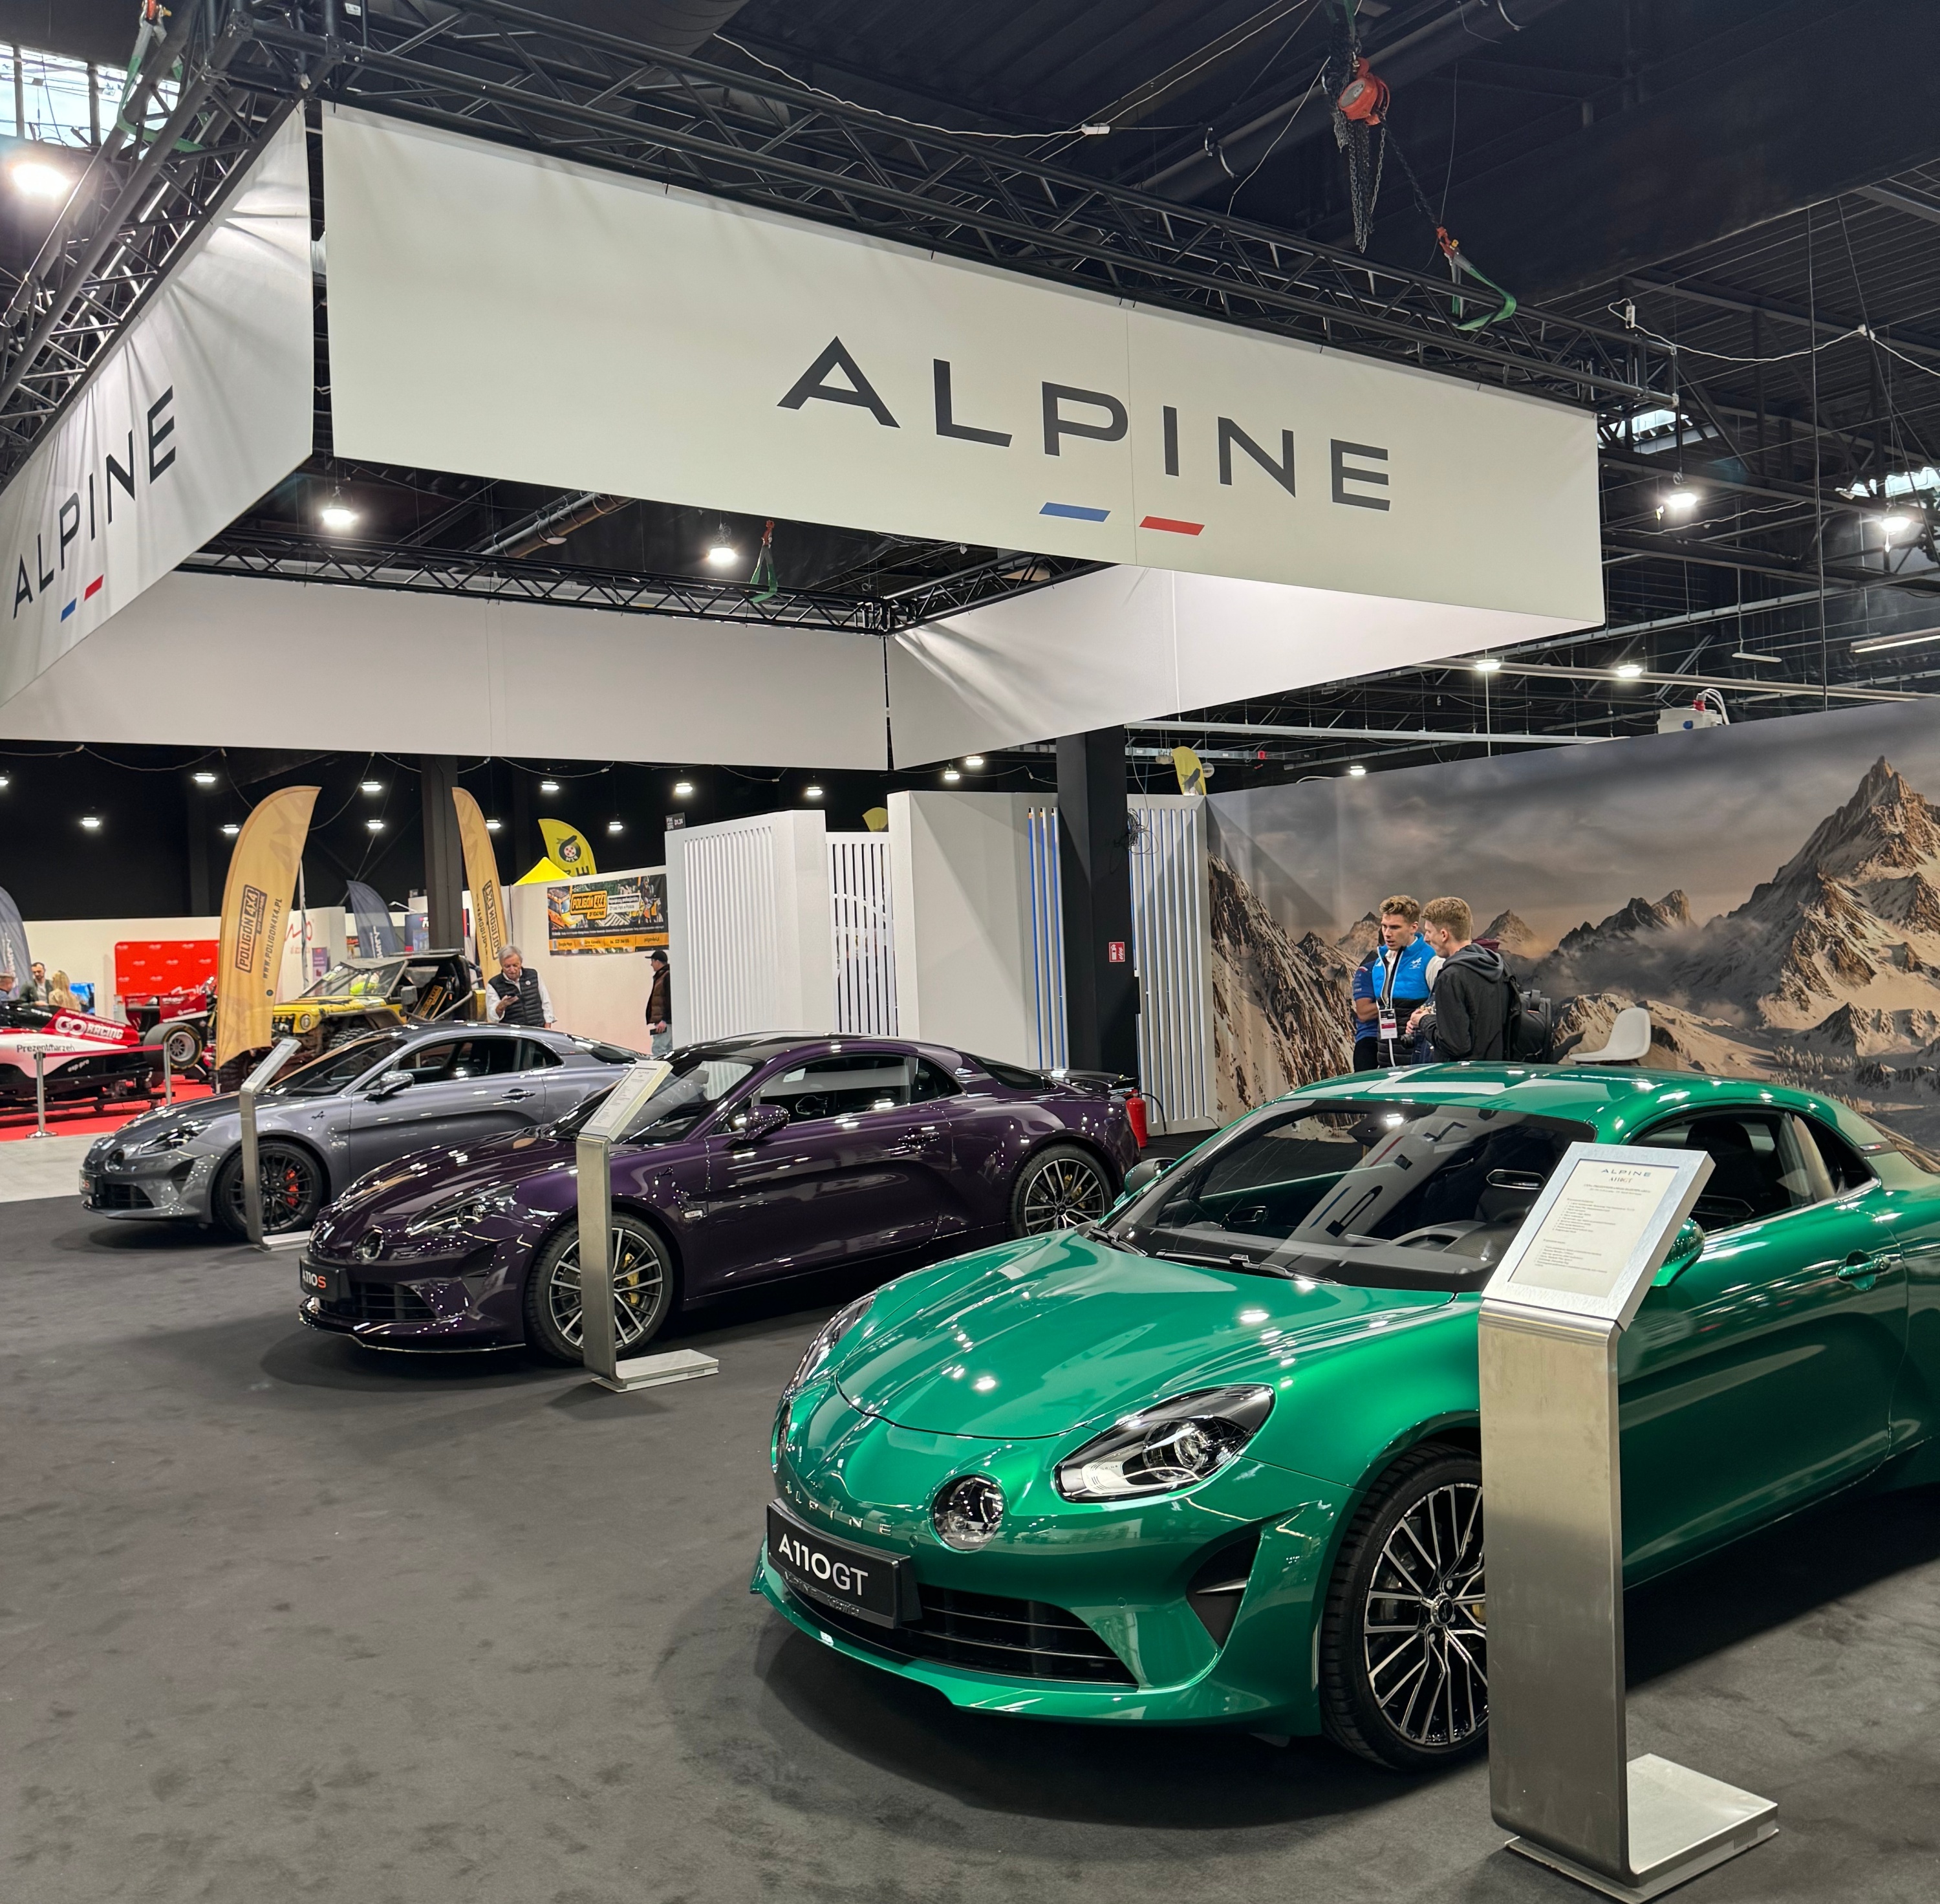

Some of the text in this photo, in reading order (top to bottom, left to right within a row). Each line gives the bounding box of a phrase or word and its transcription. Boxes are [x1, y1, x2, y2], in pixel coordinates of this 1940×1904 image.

[777, 335, 1390, 512] ALPINE
[13, 385, 177, 620] ALPINE
[245, 890, 259, 917] 4X4
[87, 1022, 124, 1040] RACING
[1601, 1168, 1652, 1177] ALPINE
[778, 1532, 868, 1596] A110GT
